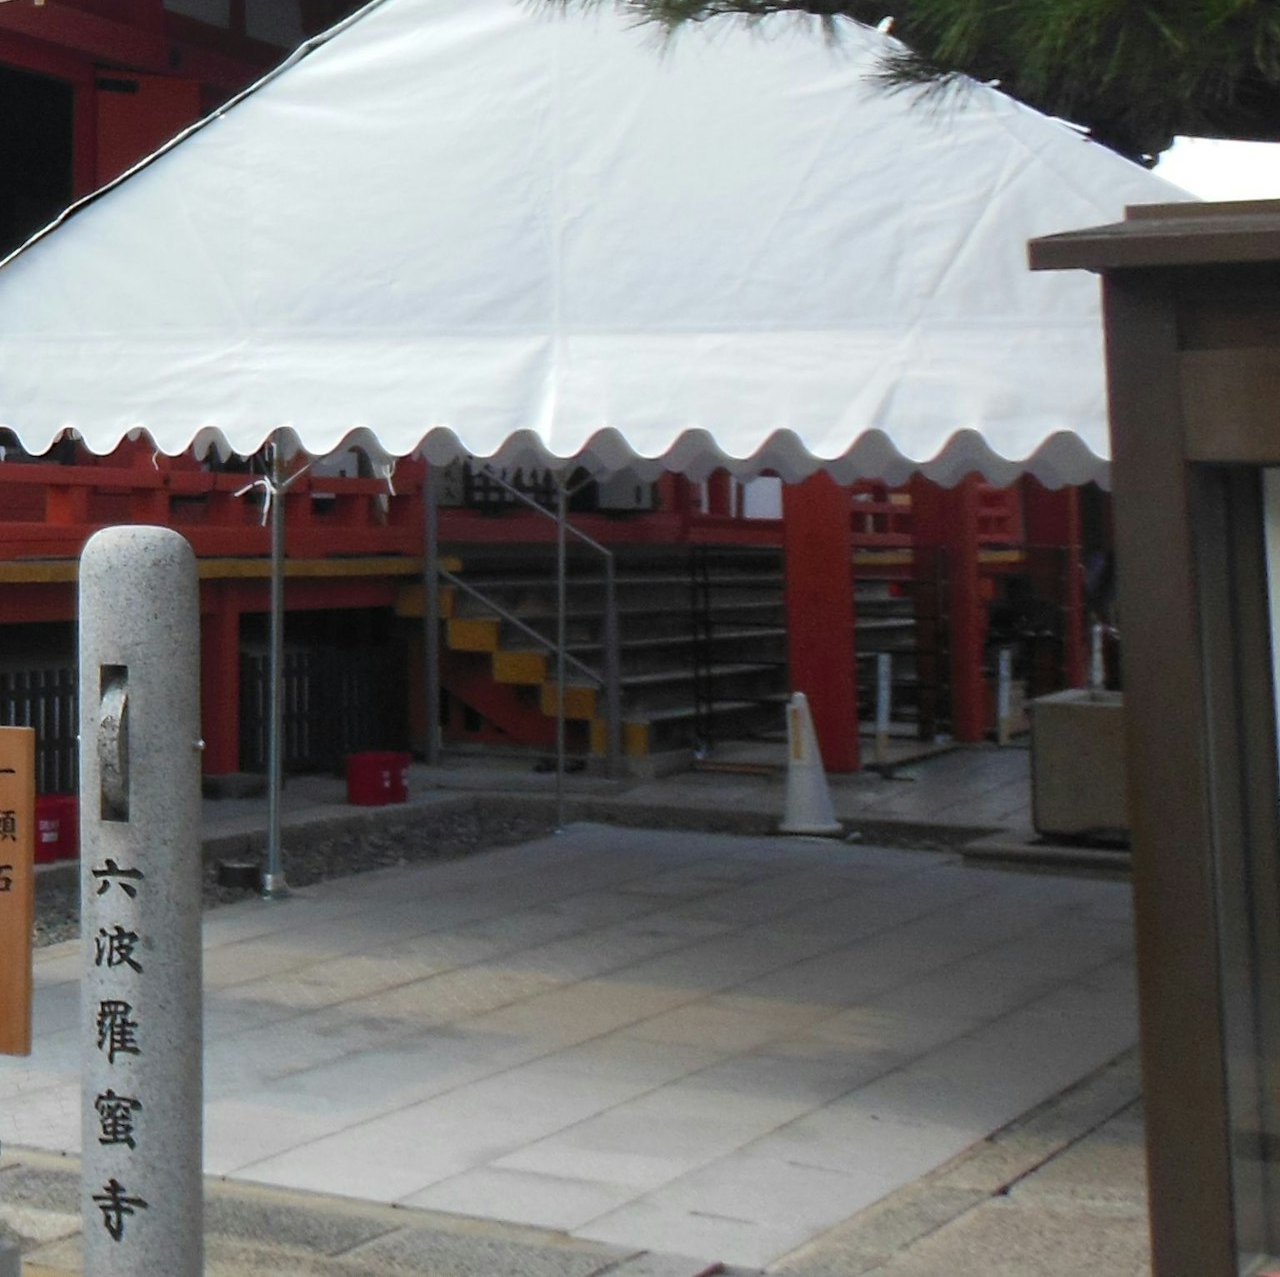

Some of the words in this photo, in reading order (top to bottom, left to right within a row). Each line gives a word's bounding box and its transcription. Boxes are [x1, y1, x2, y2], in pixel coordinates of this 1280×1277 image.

[92, 858, 149, 1243] 六波羅蜜寺
